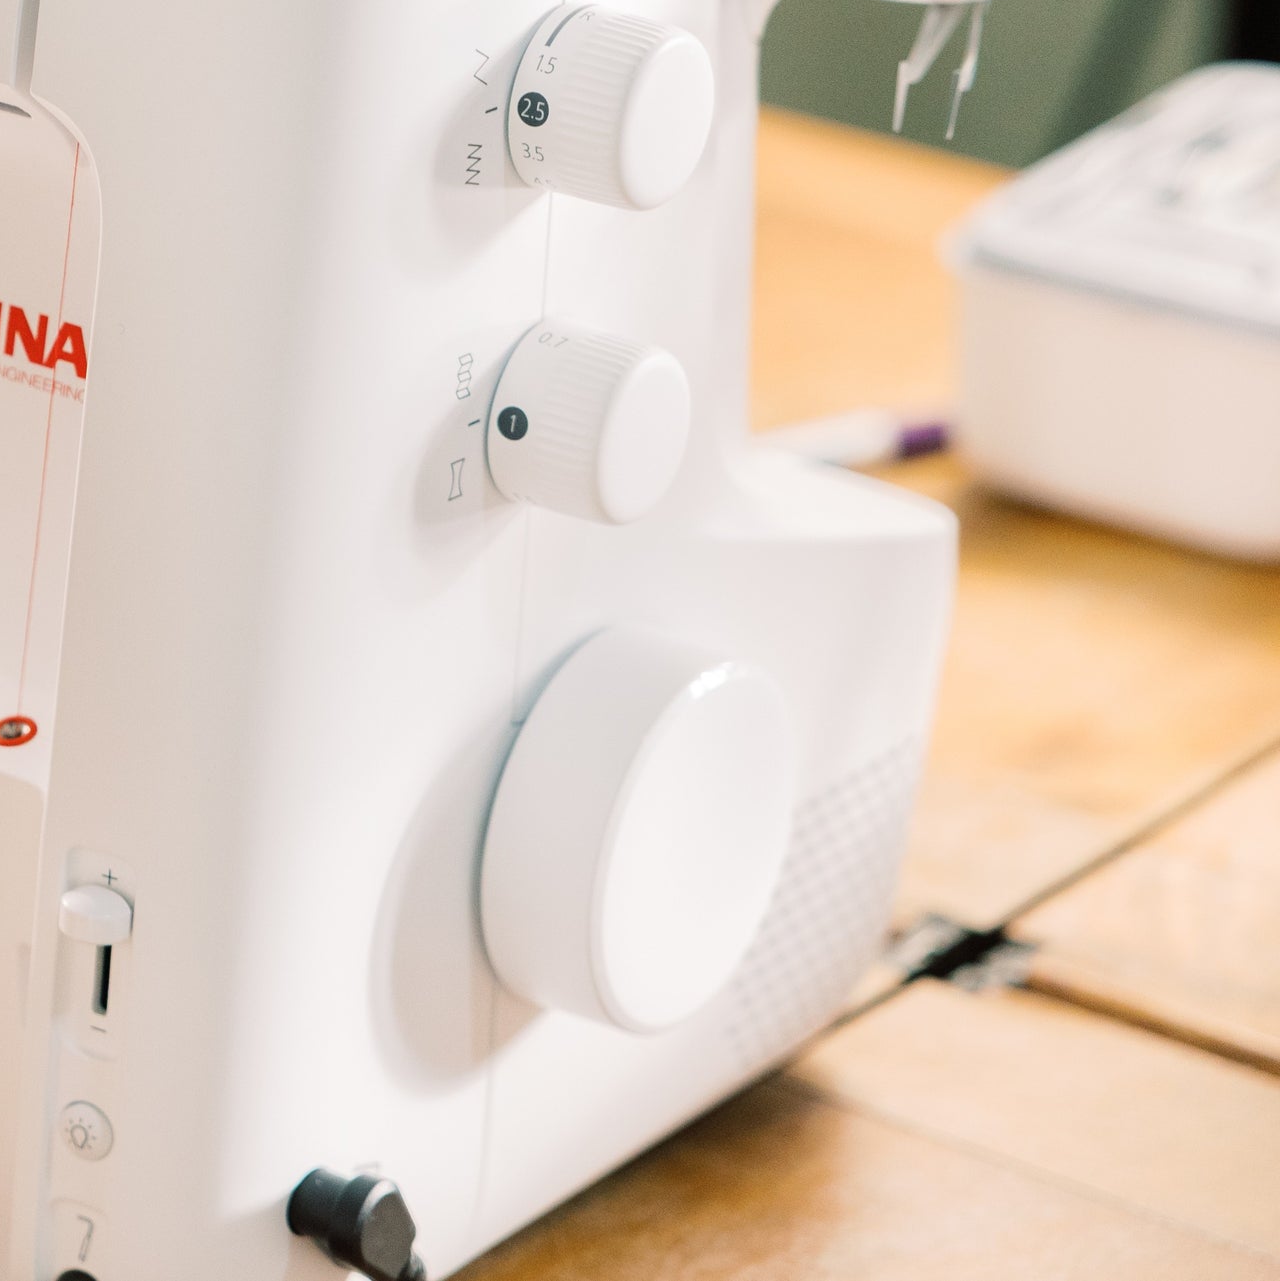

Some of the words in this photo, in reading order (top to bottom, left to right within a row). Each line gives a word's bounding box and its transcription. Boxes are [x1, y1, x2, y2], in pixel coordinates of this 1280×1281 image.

[534, 53, 558, 75] 1.5
[520, 98, 546, 122] 2.5
[521, 142, 545, 163] 3.5
[538, 331, 568, 349] 0.7
